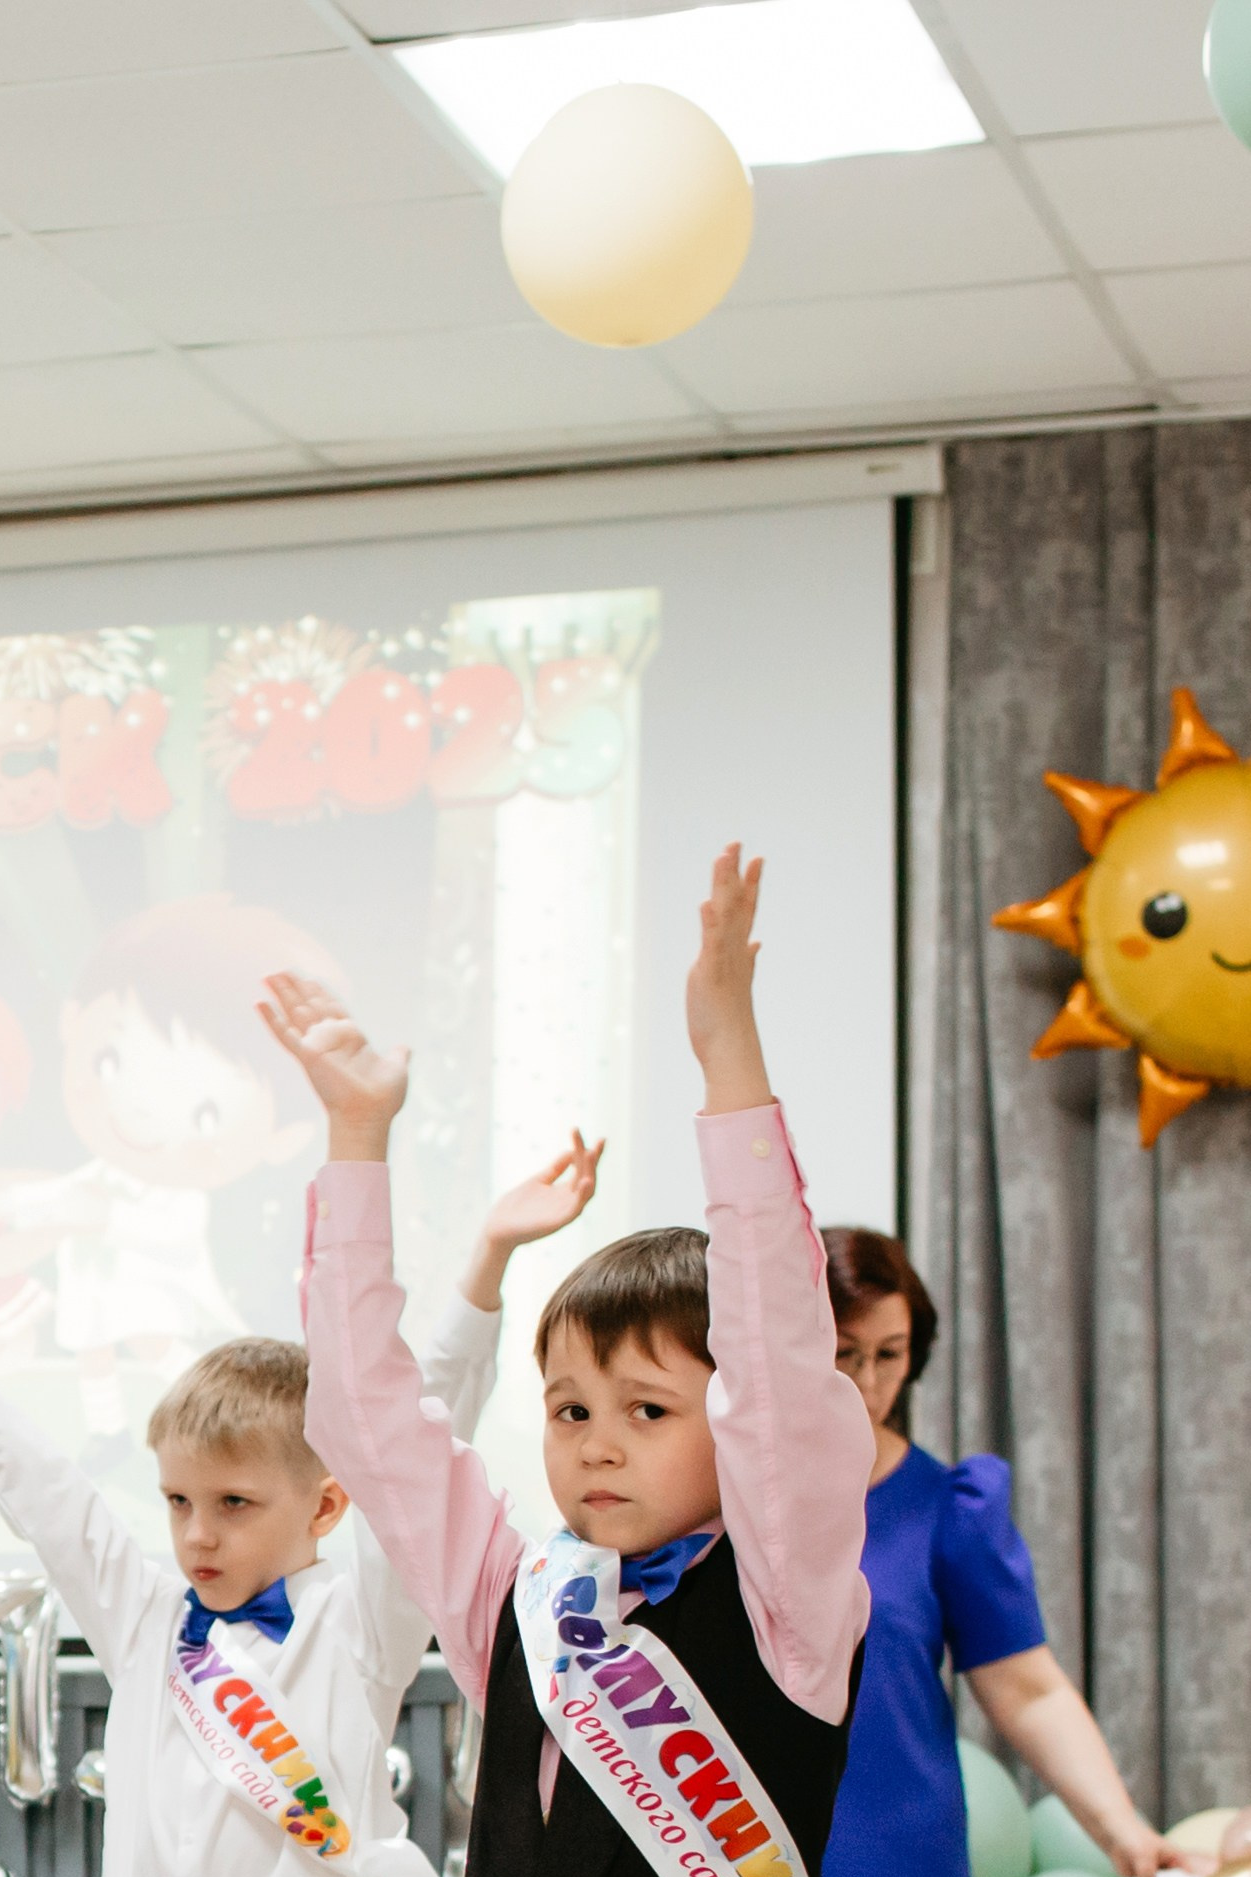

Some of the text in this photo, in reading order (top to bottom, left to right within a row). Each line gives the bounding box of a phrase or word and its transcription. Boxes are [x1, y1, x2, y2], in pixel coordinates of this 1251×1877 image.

[230, 655, 628, 818] 2025
[168, 1667, 279, 1809] детского сада
[562, 1691, 686, 1845] детского
